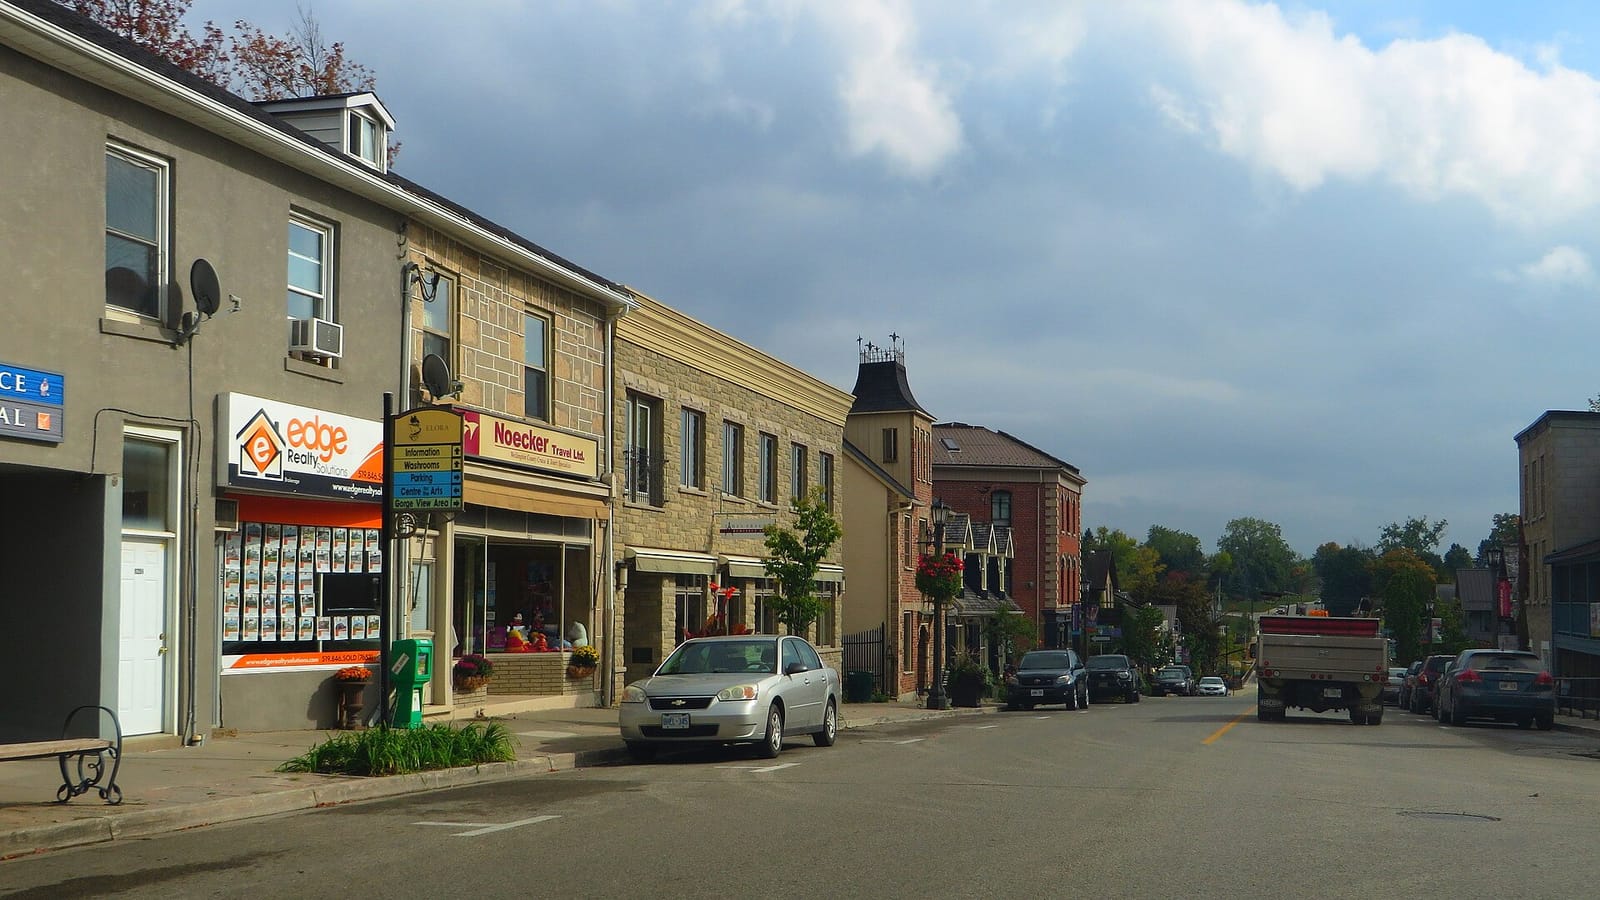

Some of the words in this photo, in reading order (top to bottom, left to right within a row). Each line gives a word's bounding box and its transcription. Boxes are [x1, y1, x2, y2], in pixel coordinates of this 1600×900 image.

[287, 415, 348, 463] edge
[494, 421, 549, 453] Noecker
[551, 444, 571, 458] Travel
[253, 435, 270, 463] e
[405, 447, 440, 457] Information
[287, 449, 319, 469] Realty
[404, 460, 440, 470] Washrooms
[316, 462, 350, 477] Solutions
[410, 473, 433, 484] Parking
[400, 487, 422, 496] Centre
[430, 486, 443, 495] Arts
[395, 499, 414, 508] Gorge
[415, 499, 431, 507] View
[433, 499, 449, 507] Area
